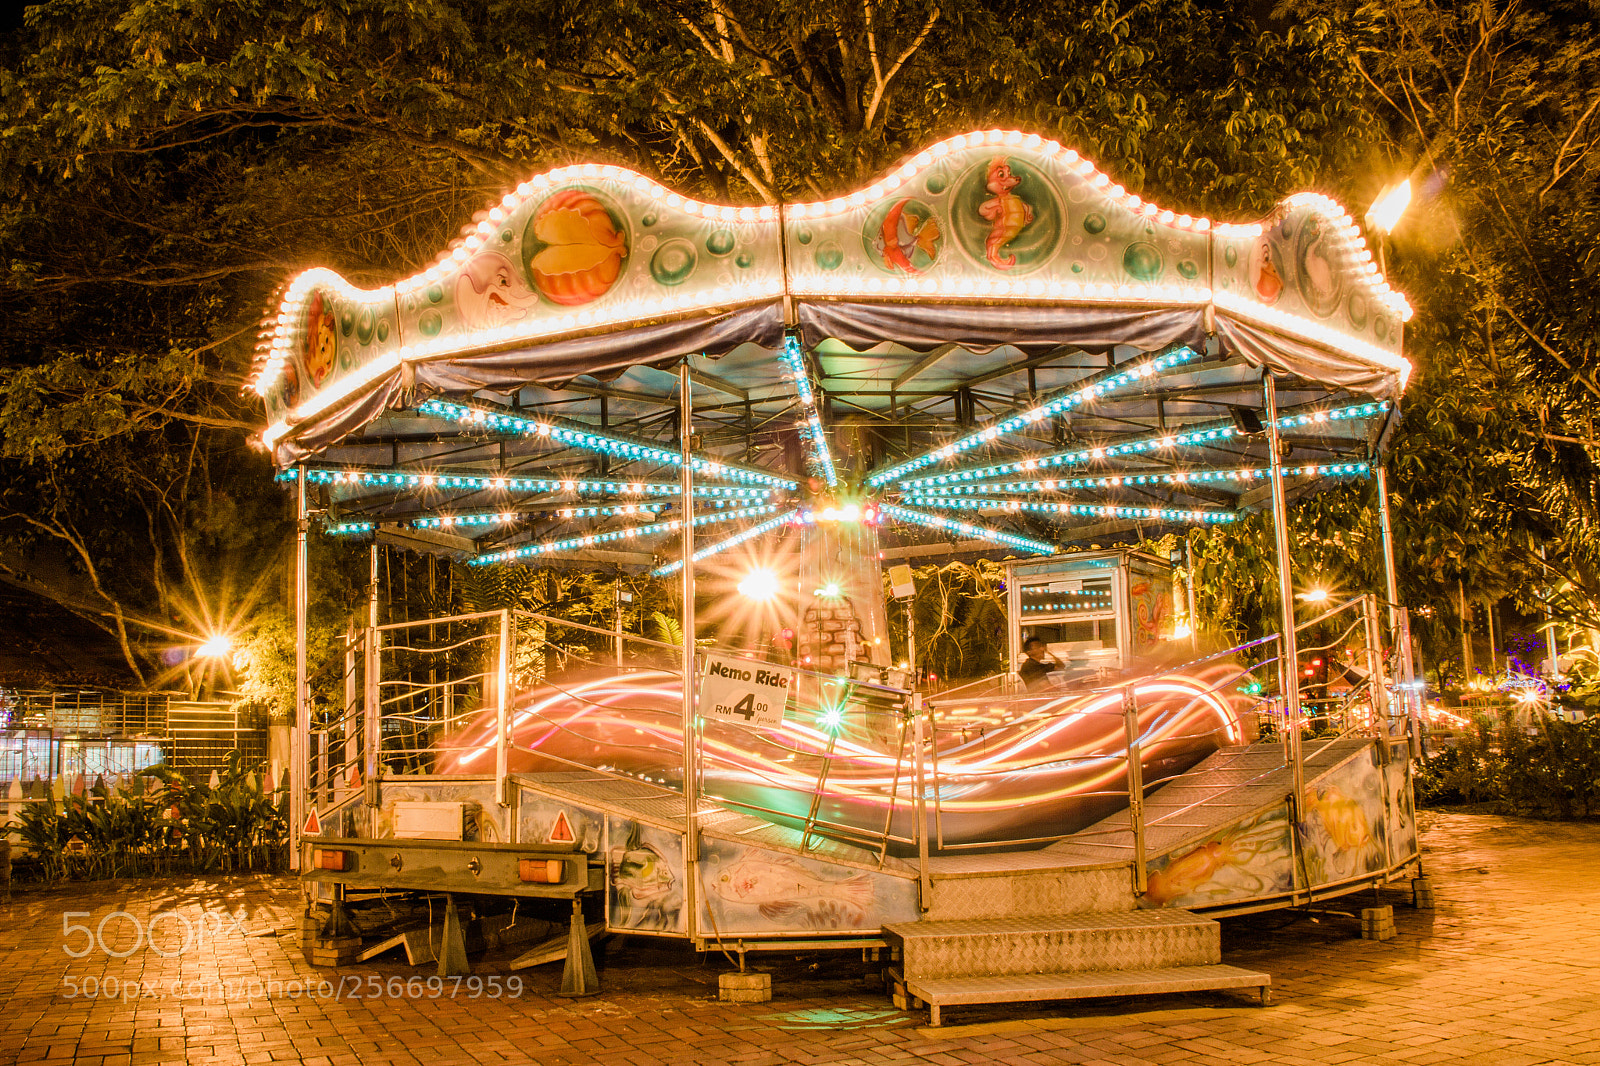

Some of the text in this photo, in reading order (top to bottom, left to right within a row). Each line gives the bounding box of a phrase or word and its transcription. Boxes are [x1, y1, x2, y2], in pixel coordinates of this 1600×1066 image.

[709, 661, 788, 689] Nemo Ride
[715, 704, 732, 716] RM
